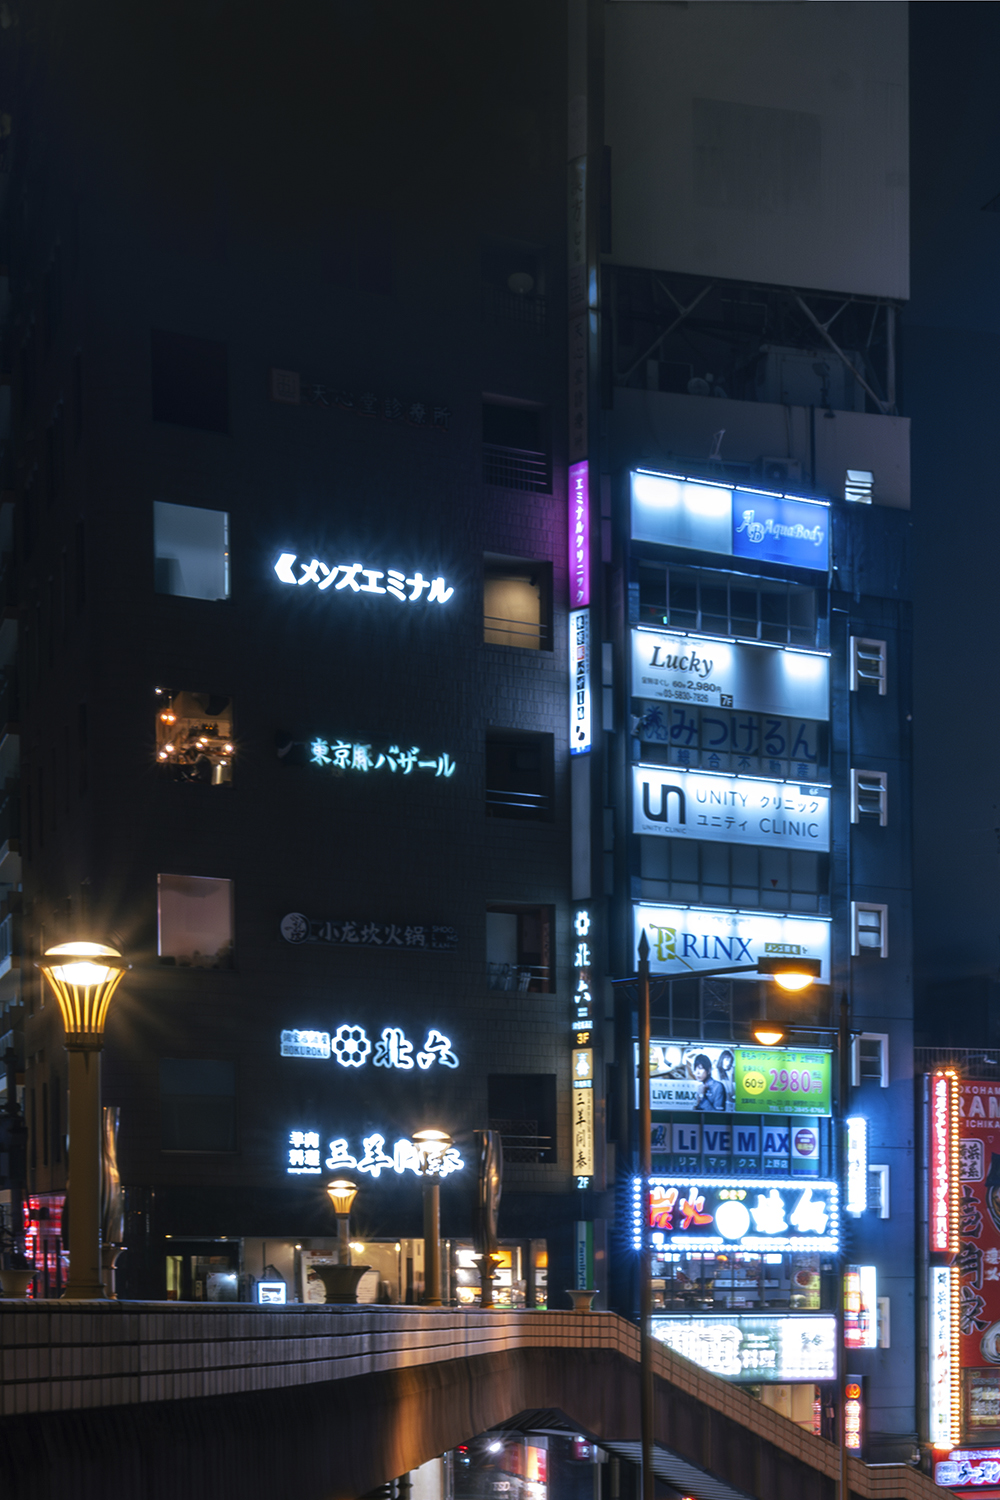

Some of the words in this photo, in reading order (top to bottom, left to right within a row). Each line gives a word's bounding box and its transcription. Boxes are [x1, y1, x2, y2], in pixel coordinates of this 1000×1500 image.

[298, 556, 455, 604] メンズエミナル
[649, 645, 714, 678] Lucky
[670, 709, 817, 760] みつけるん
[696, 788, 749, 808] UNITY
[760, 795, 819, 814] クリニック
[697, 814, 748, 831] ユニティ
[759, 817, 820, 838] CLINIC
[318, 920, 427, 947] 小龙坎火锅
[681, 932, 755, 963] RINX
[576, 1032, 590, 1044] 3F
[283, 1045, 330, 1058] HOKUROKU
[675, 1090, 697, 1101] MAX
[738, 1131, 790, 1154] MAX
[765, 1157, 789, 1169] 上野店
[577, 1176, 590, 1189] 2F
